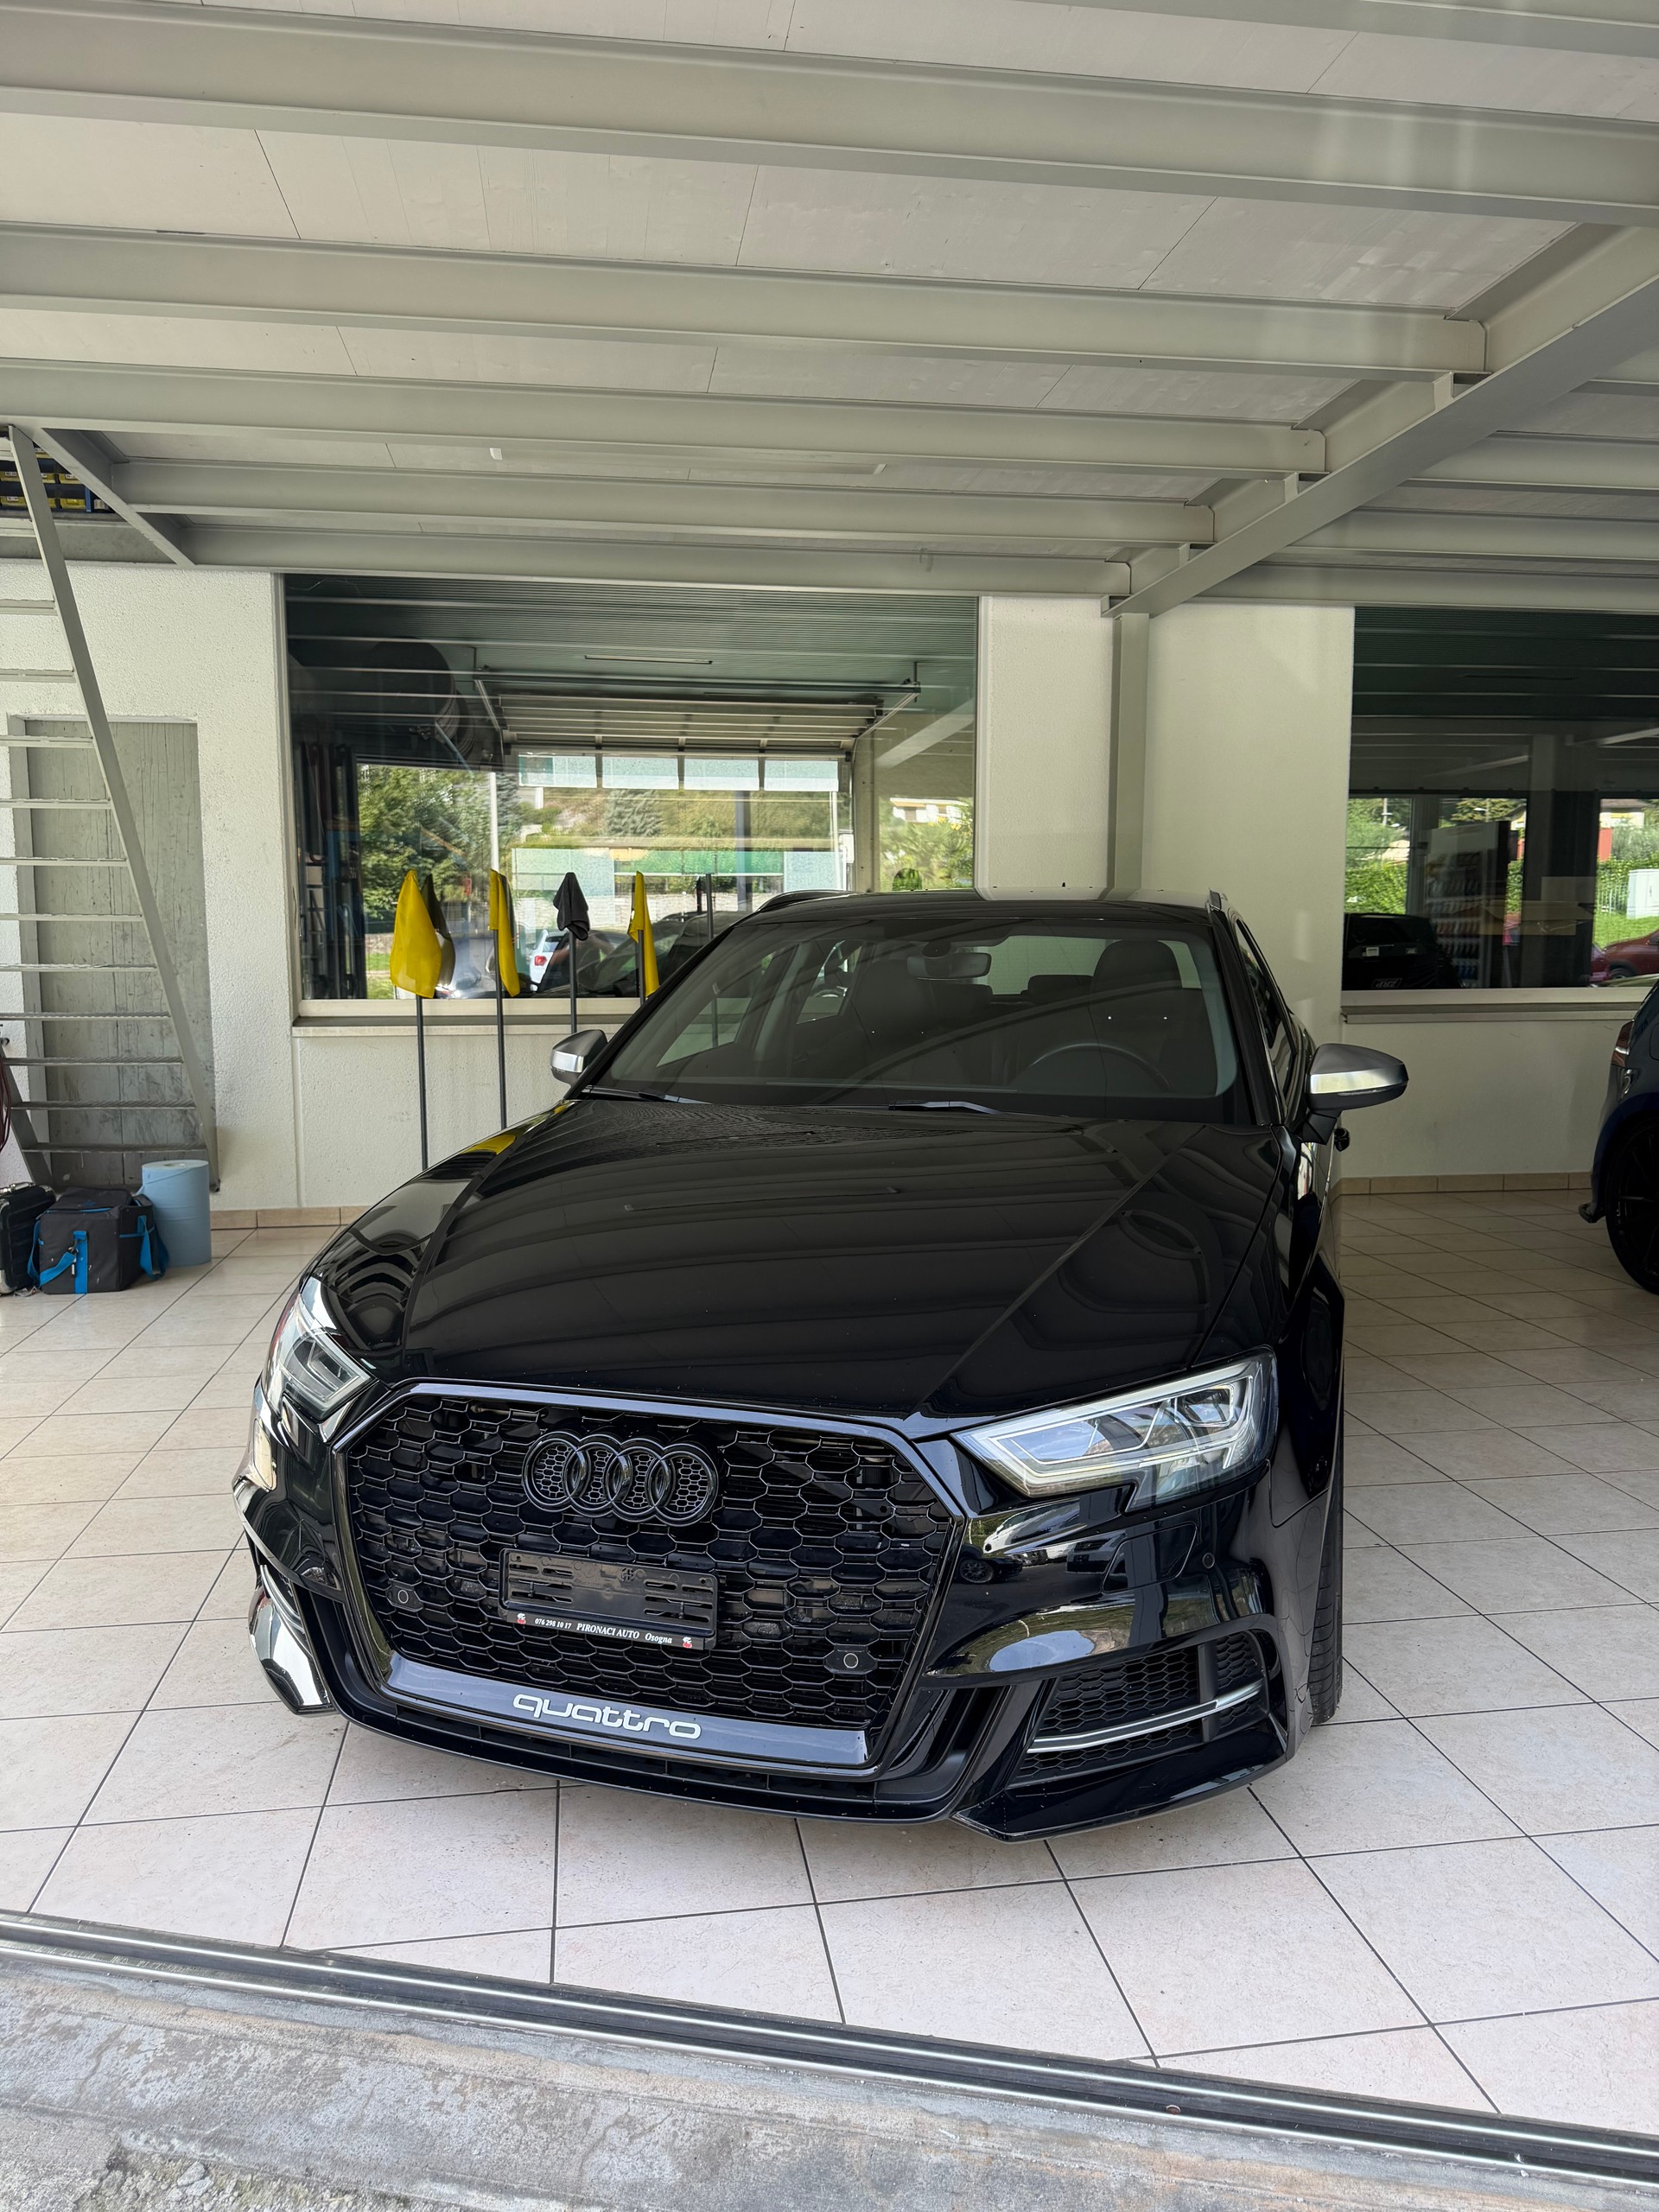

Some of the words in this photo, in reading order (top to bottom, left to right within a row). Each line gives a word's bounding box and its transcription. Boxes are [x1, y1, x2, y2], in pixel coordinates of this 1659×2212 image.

[576, 1623, 616, 1636] PIRONACI
[616, 1629, 640, 1639] AUTO
[645, 1632, 673, 1644] Osogna
[512, 1694, 702, 1739] quattro
